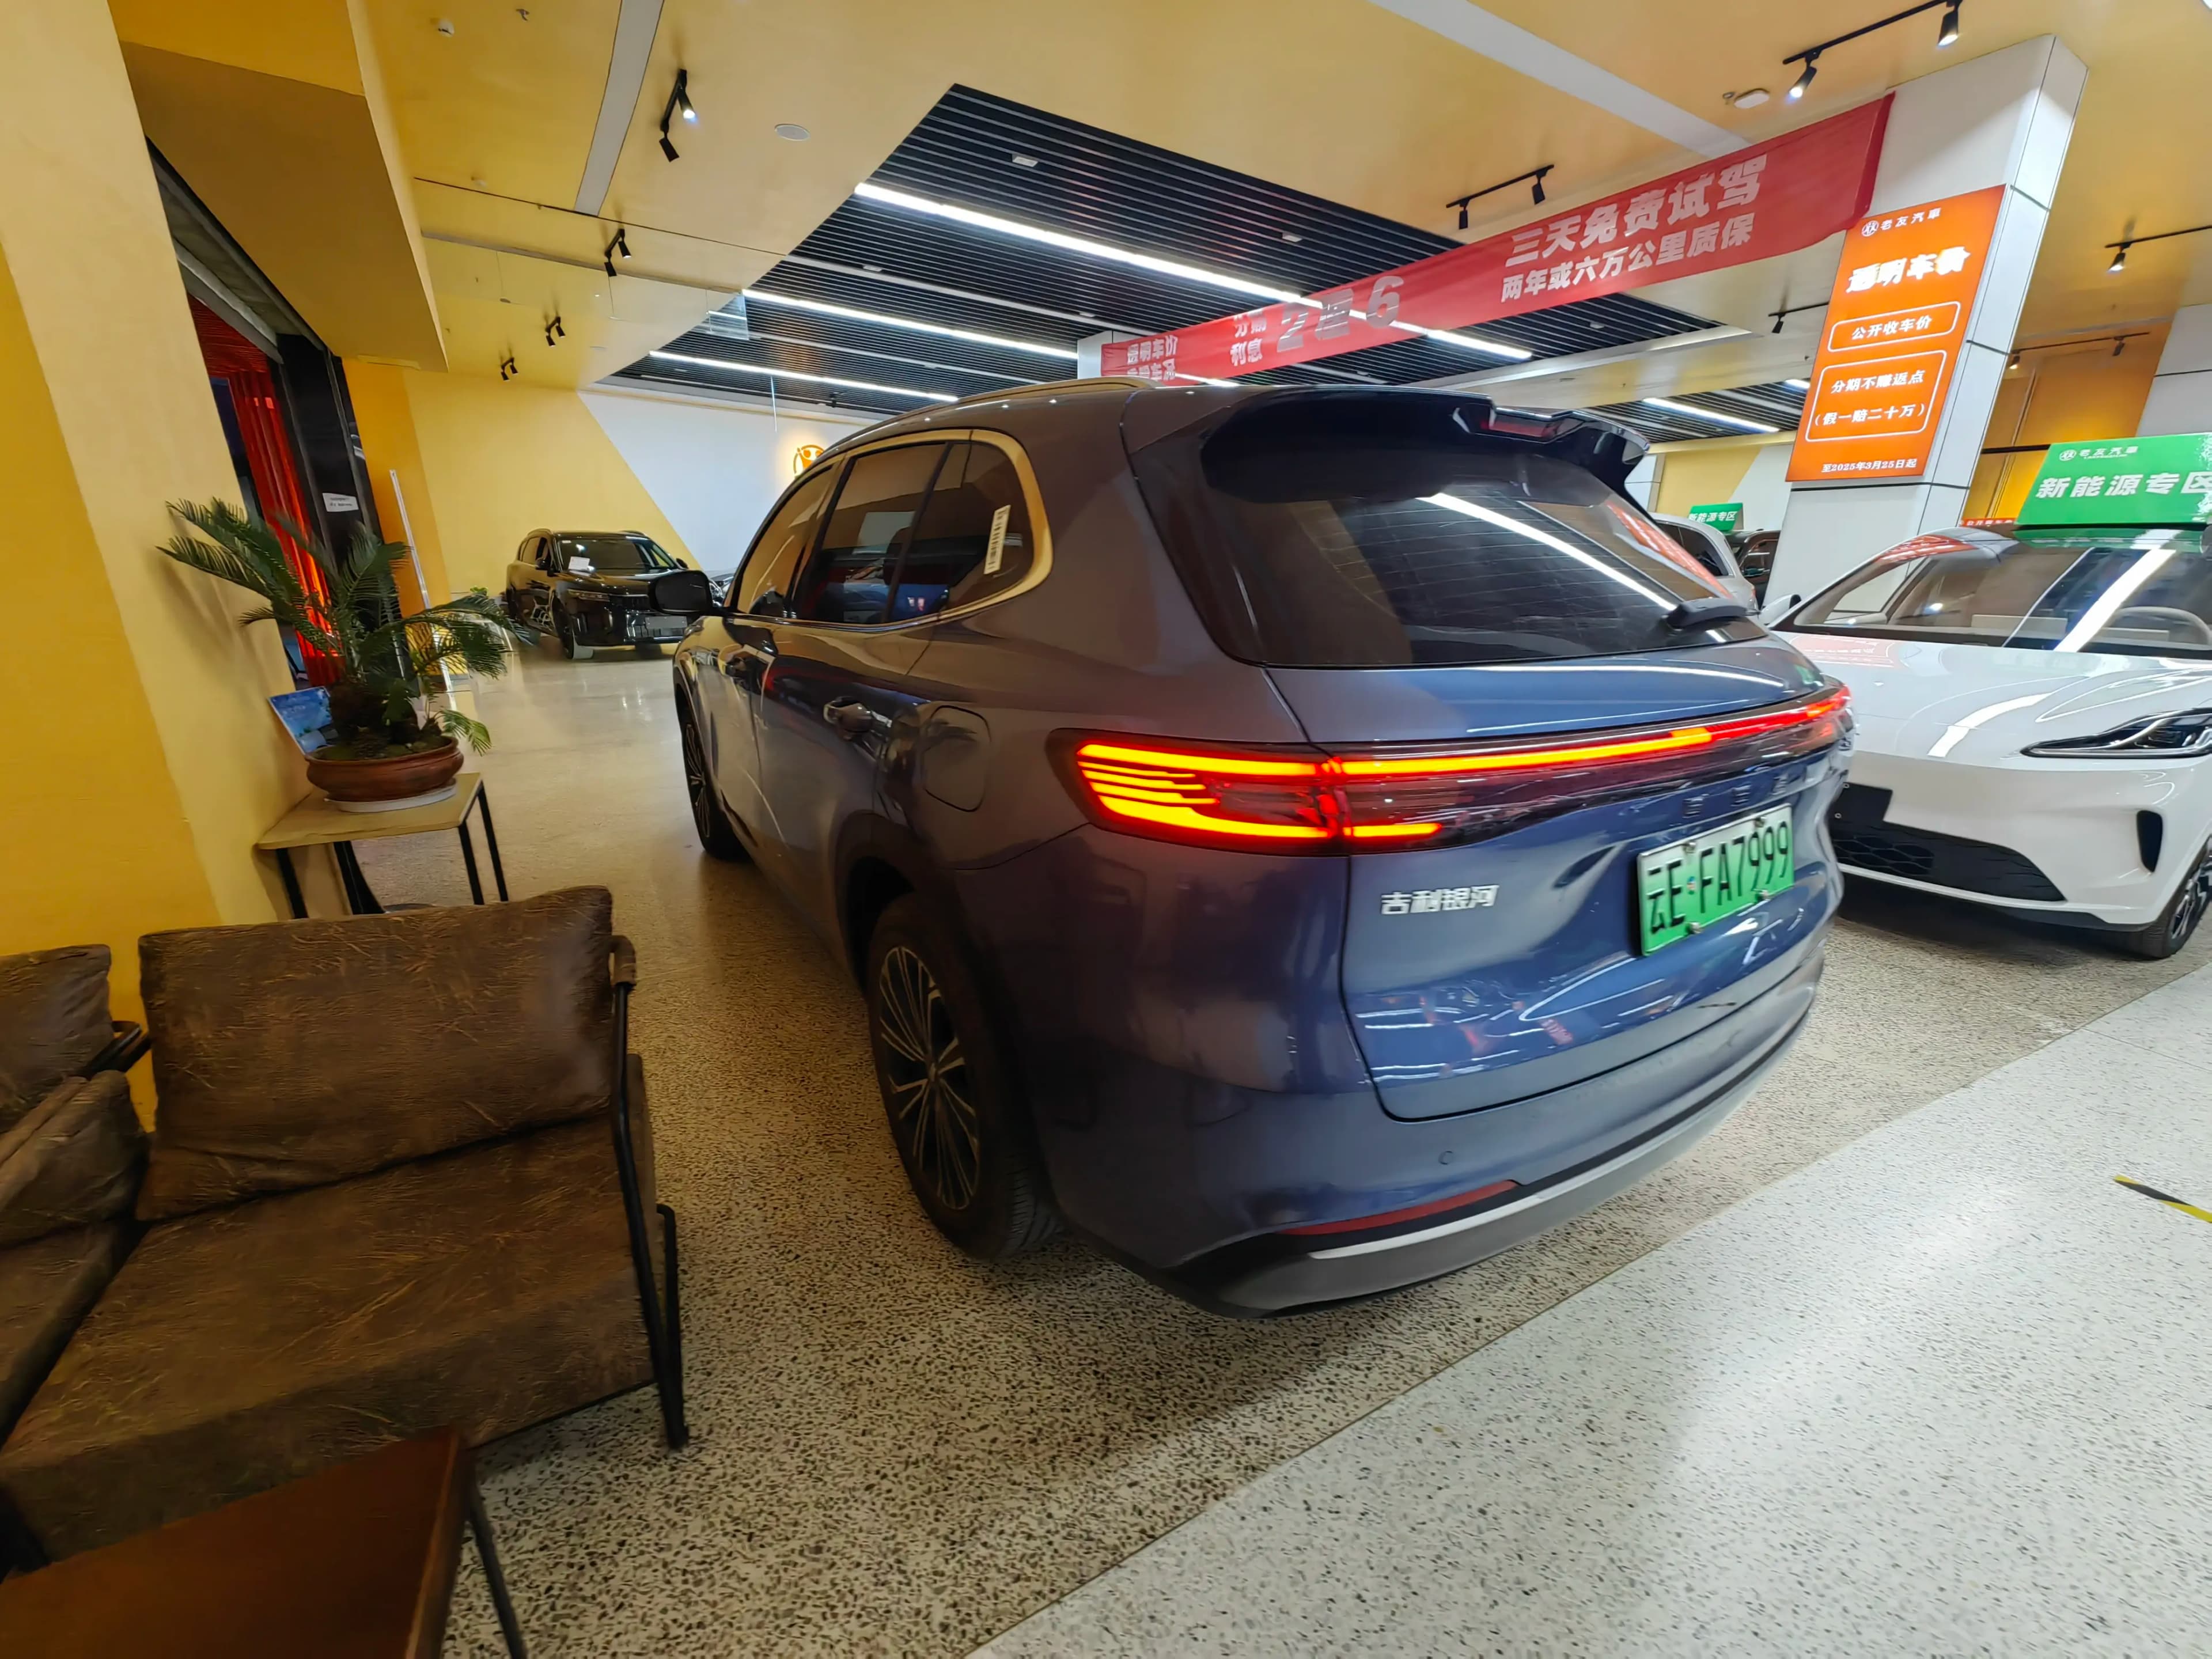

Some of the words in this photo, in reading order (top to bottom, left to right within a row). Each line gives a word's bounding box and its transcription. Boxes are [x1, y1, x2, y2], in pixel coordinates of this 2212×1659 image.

[1505, 154, 1767, 268] 三天免费试驾
[1501, 213, 1756, 302] 两年或六万公里质保
[1851, 315, 1933, 340] 公开收车价
[1230, 337, 1263, 366] 利息
[1831, 370, 1925, 393] 分期不赚返点
[2035, 472, 2212, 498] 新能源专区
[1688, 511, 1738, 522] 新能源专区
[1381, 884, 1499, 915] 吉利银河
